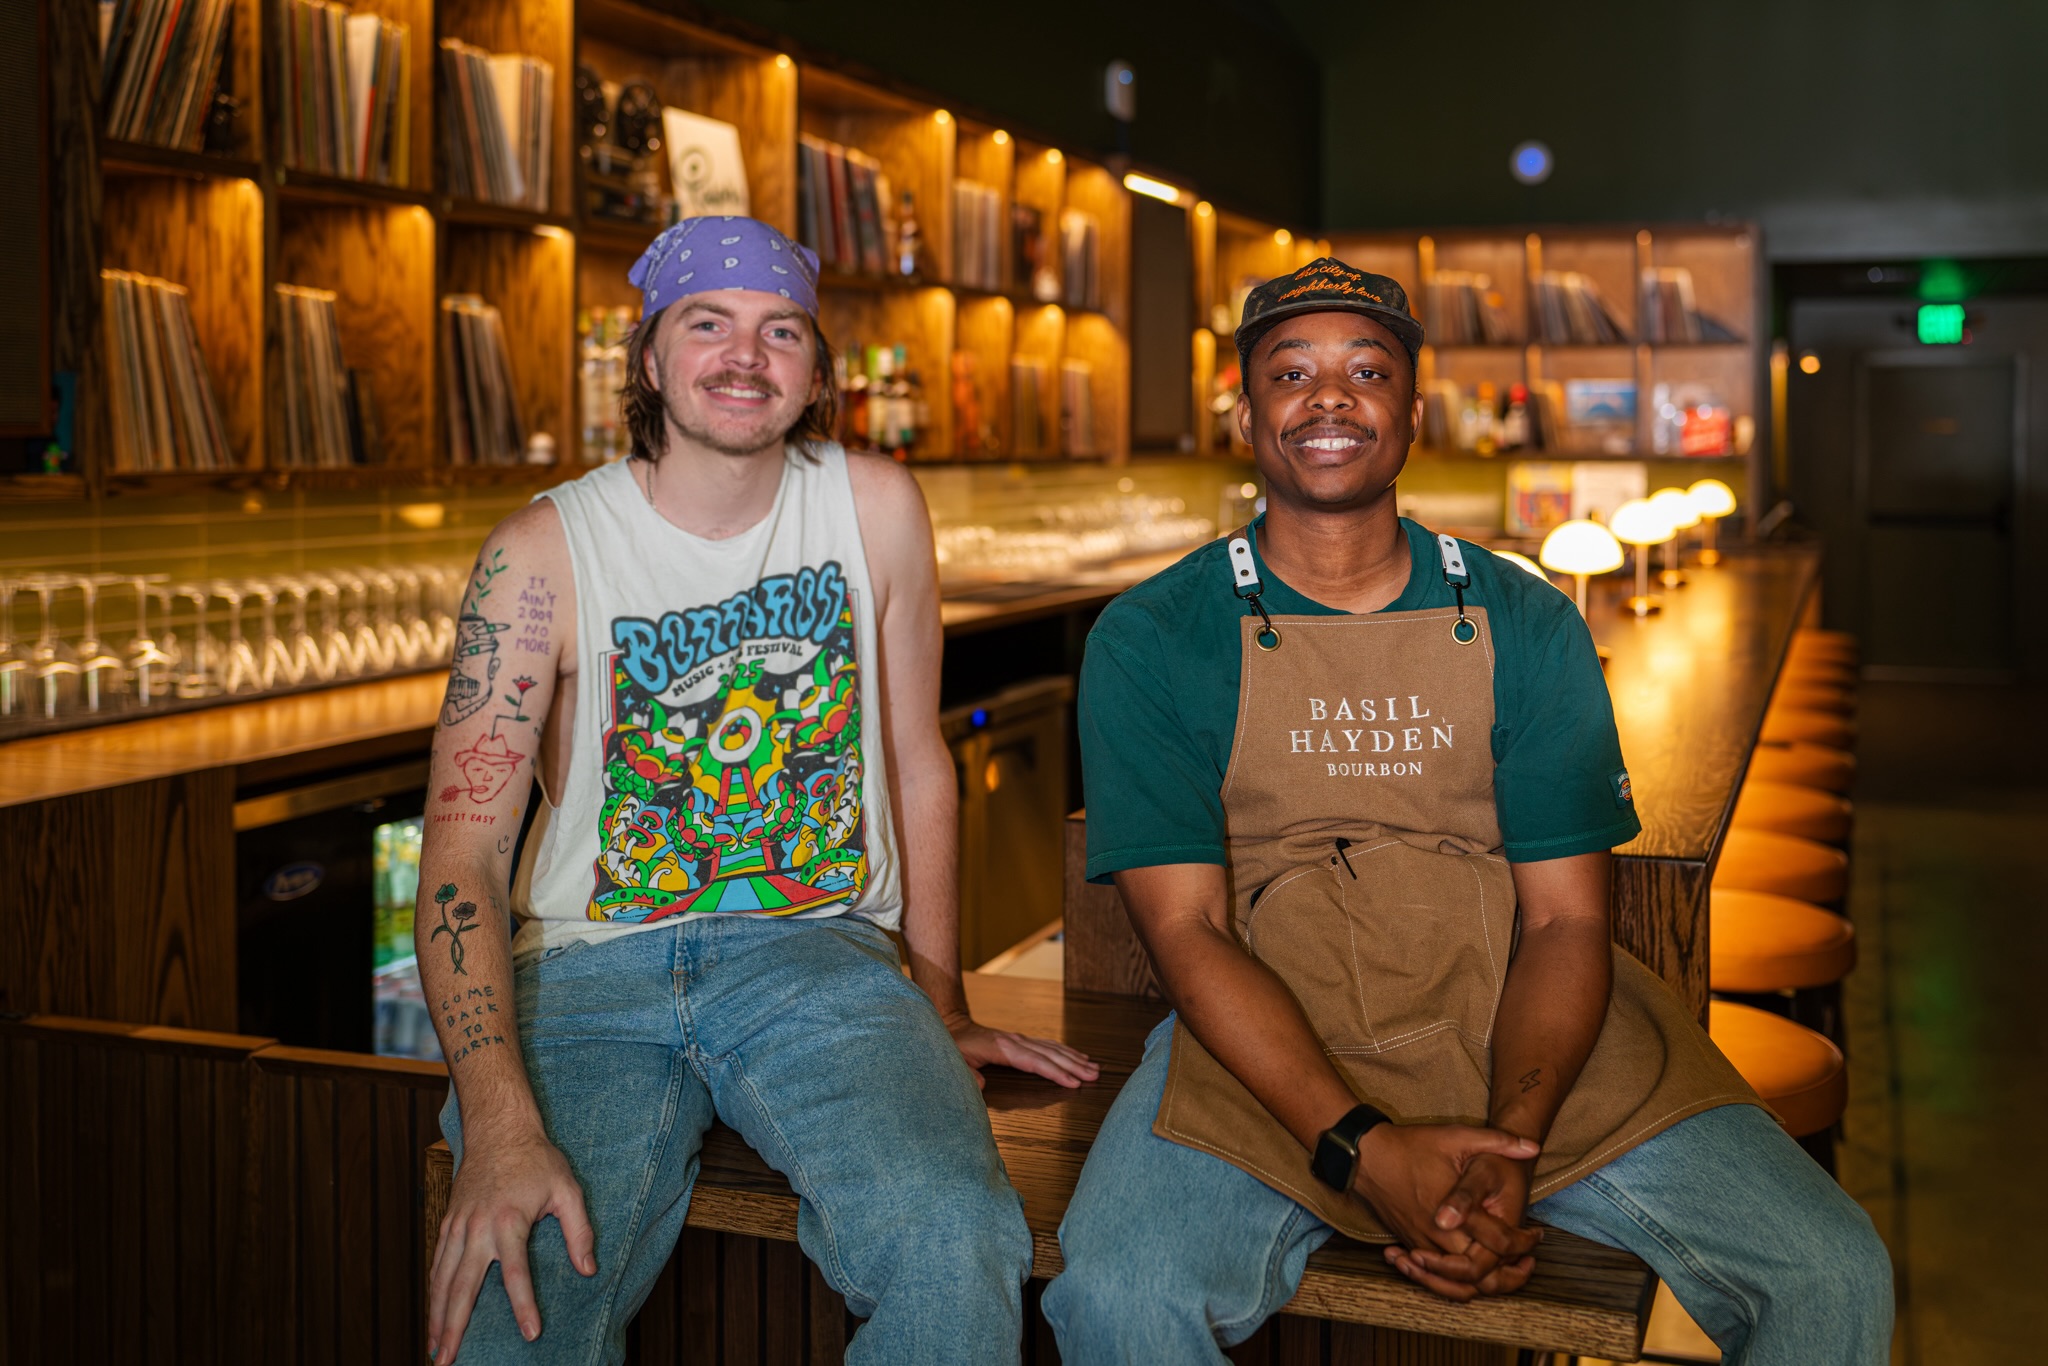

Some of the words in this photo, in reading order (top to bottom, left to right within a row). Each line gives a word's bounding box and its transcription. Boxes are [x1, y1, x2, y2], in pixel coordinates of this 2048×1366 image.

[1319, 265, 1346, 277] city
[1346, 272, 1362, 281] of
[1277, 278, 1354, 302] neighborly
[528, 575, 548, 590] IT
[518, 589, 557, 608] AIN'T
[517, 606, 553, 624] 2009
[524, 623, 549, 638] NO
[515, 637, 551, 656] MORE
[671, 665, 715, 698] MUSIC
[746, 641, 804, 657] FESTIVAL
[716, 657, 766, 700] 225
[1308, 695, 1430, 722] BASIL
[1326, 761, 1423, 776] BOURBON
[433, 813, 453, 823] TAKE
[454, 812, 466, 821] IT
[470, 813, 497, 826] EASY
[441, 985, 495, 1011] COME
[446, 1003, 499, 1028] BACK
[463, 1023, 483, 1038] TO
[453, 1035, 505, 1064] EARTH
